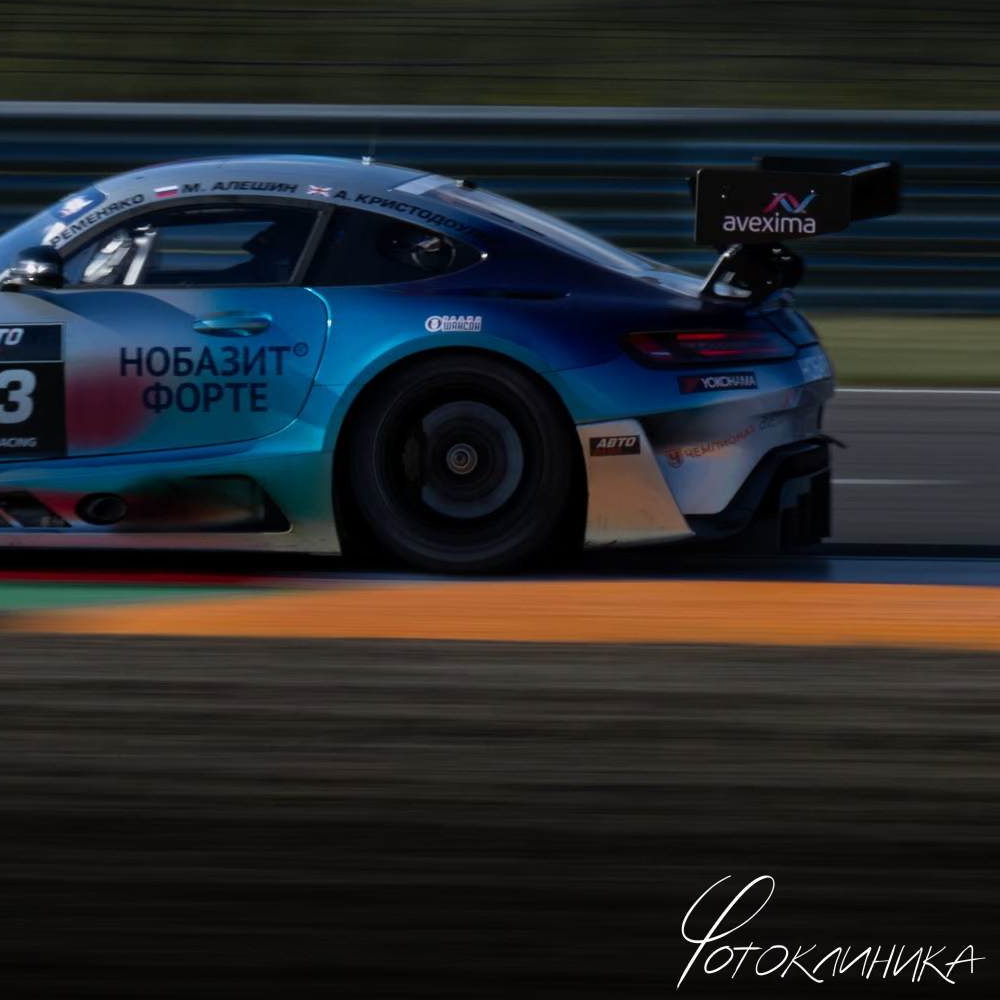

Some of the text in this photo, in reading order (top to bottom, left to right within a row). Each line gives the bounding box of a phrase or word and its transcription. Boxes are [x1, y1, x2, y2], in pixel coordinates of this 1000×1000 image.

[211, 181, 298, 194] АЛЕШИН
[722, 212, 817, 234] avexima
[701, 375, 756, 388] YOKOHAMA
[142, 382, 269, 414] ФОРТЕ
[596, 436, 637, 449] АВТО
